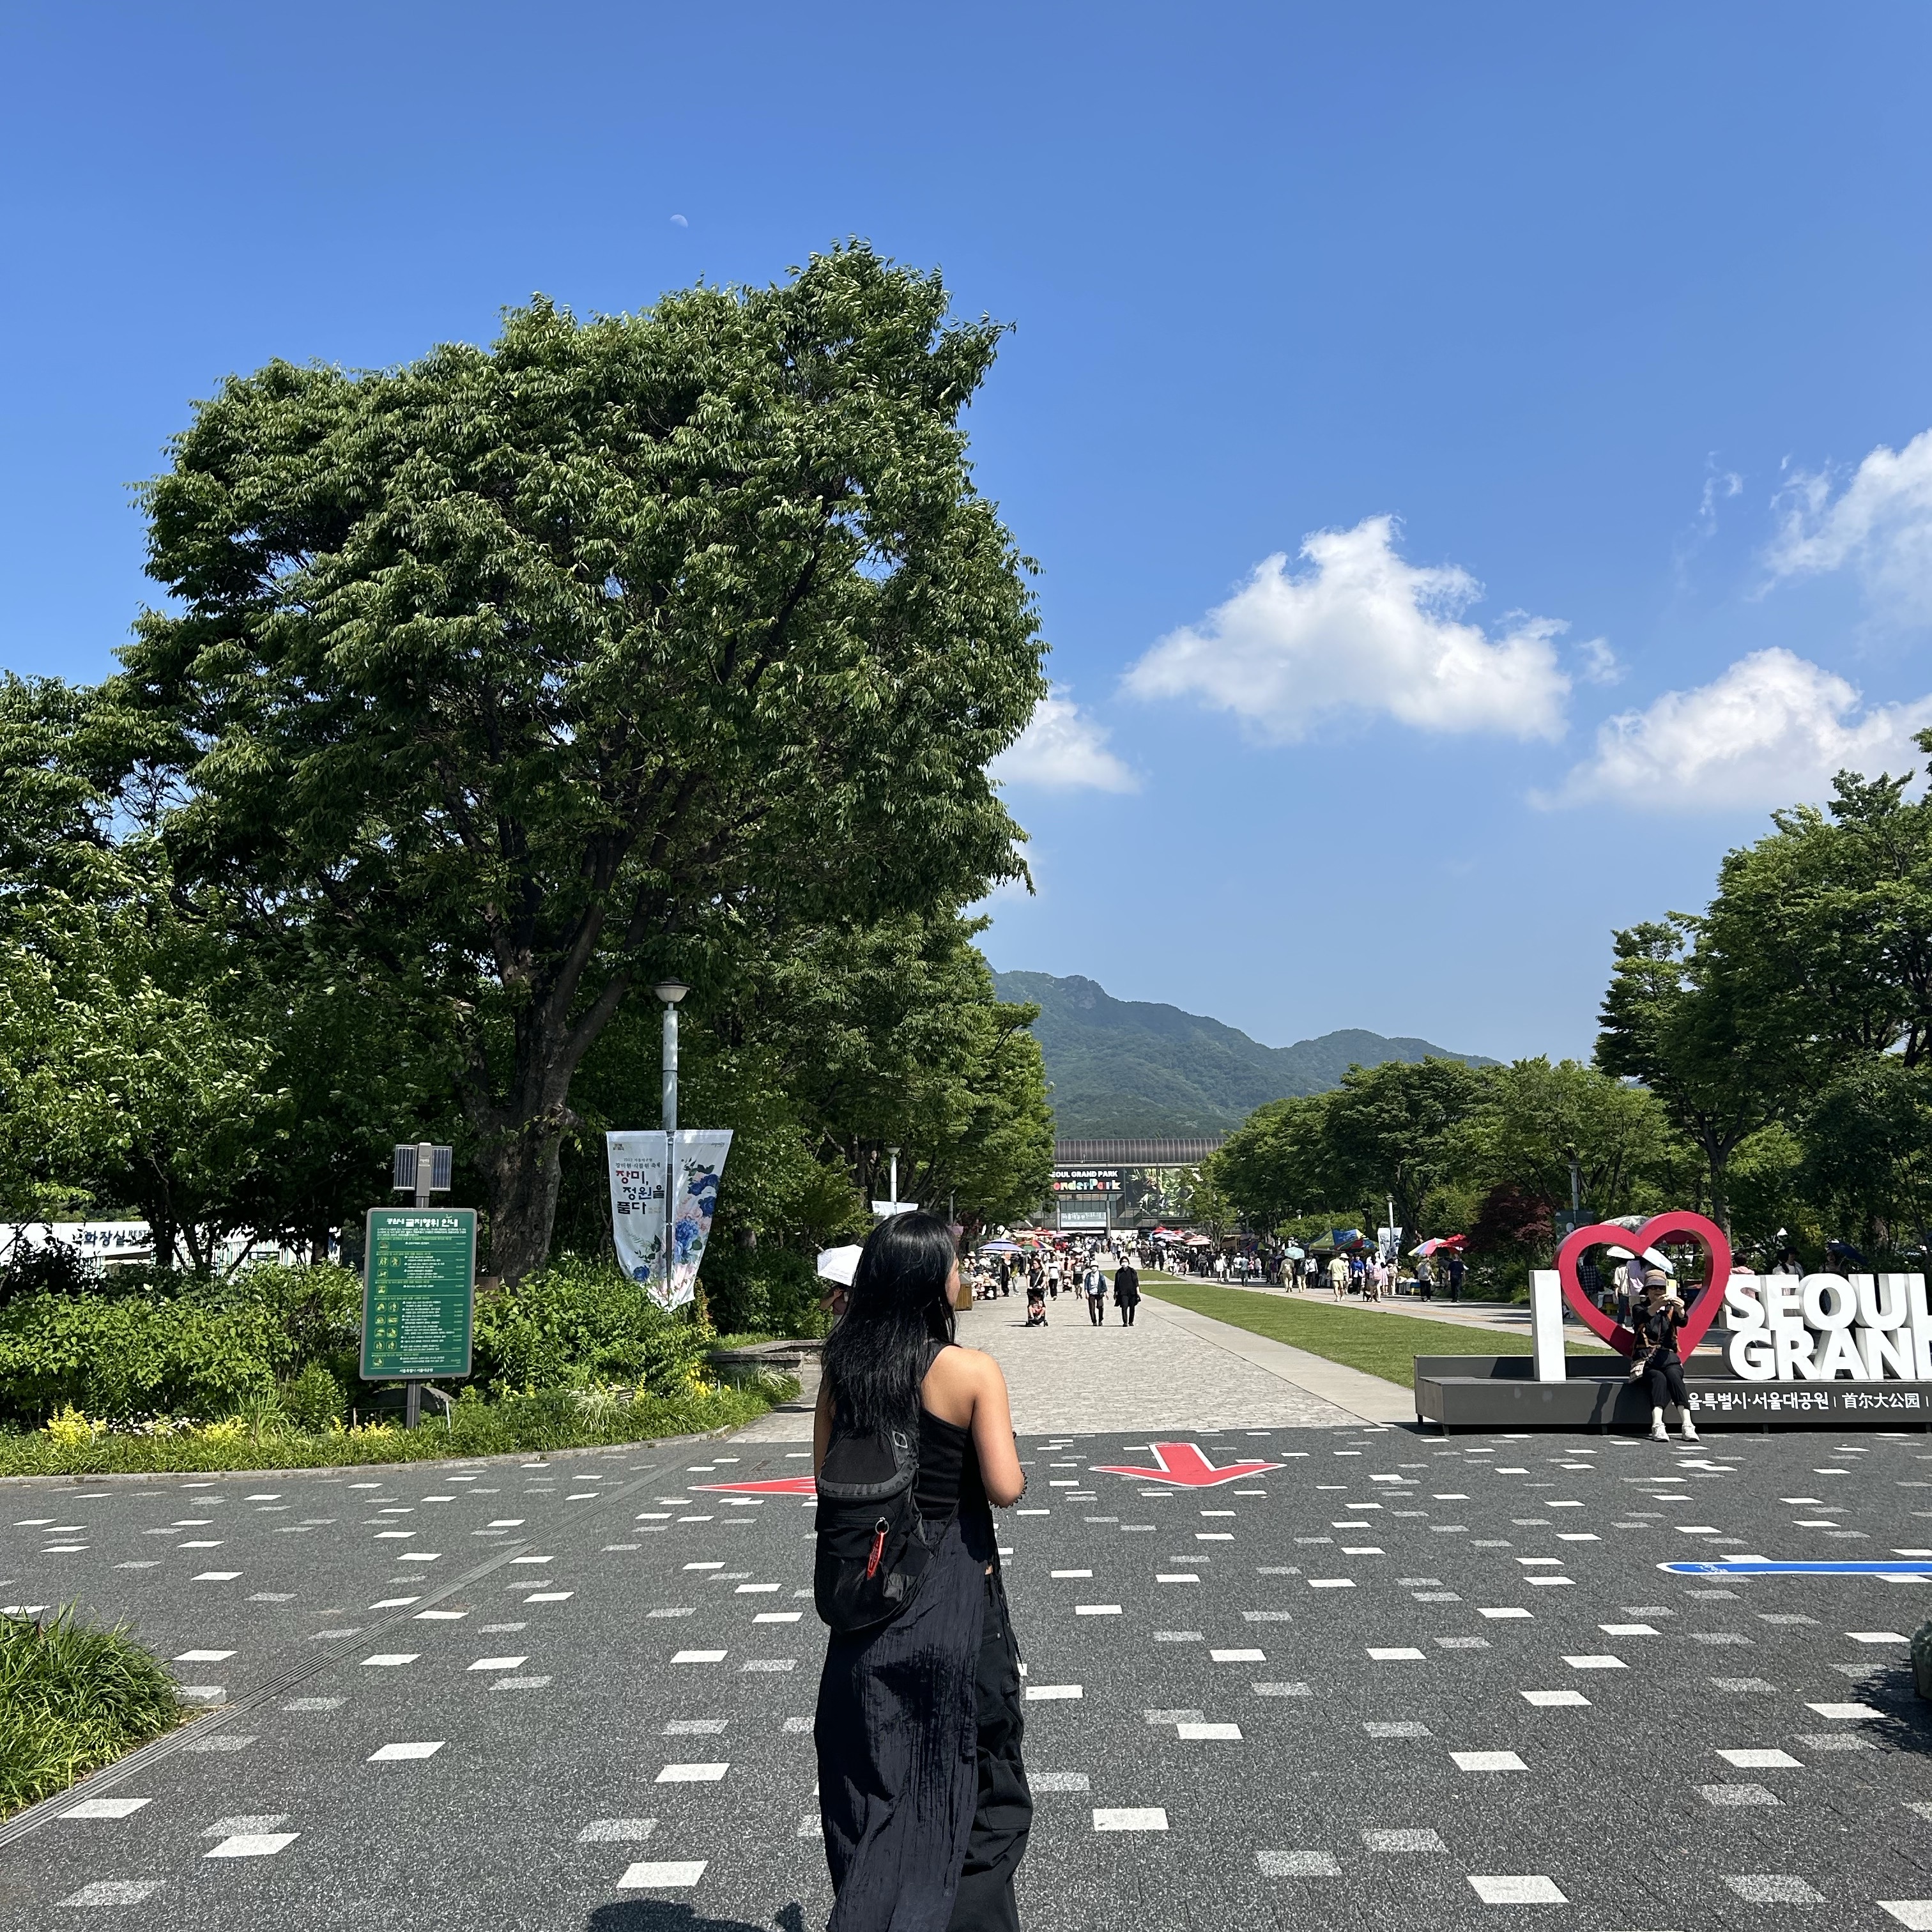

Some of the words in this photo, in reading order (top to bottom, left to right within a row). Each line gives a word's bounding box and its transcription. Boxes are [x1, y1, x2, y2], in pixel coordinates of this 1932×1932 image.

[615, 1170, 649, 1185] 장미,
[1053, 1178, 1121, 1191] onderPark
[622, 1184, 665, 1200] 정원을
[617, 1201, 647, 1215] 품다
[84, 1230, 125, 1248] 화장실
[1529, 1270, 1567, 1381] I
[1687, 1392, 1829, 1411] 울특별시·서울대공원
[1841, 1392, 1920, 1409] 首尔大公园
